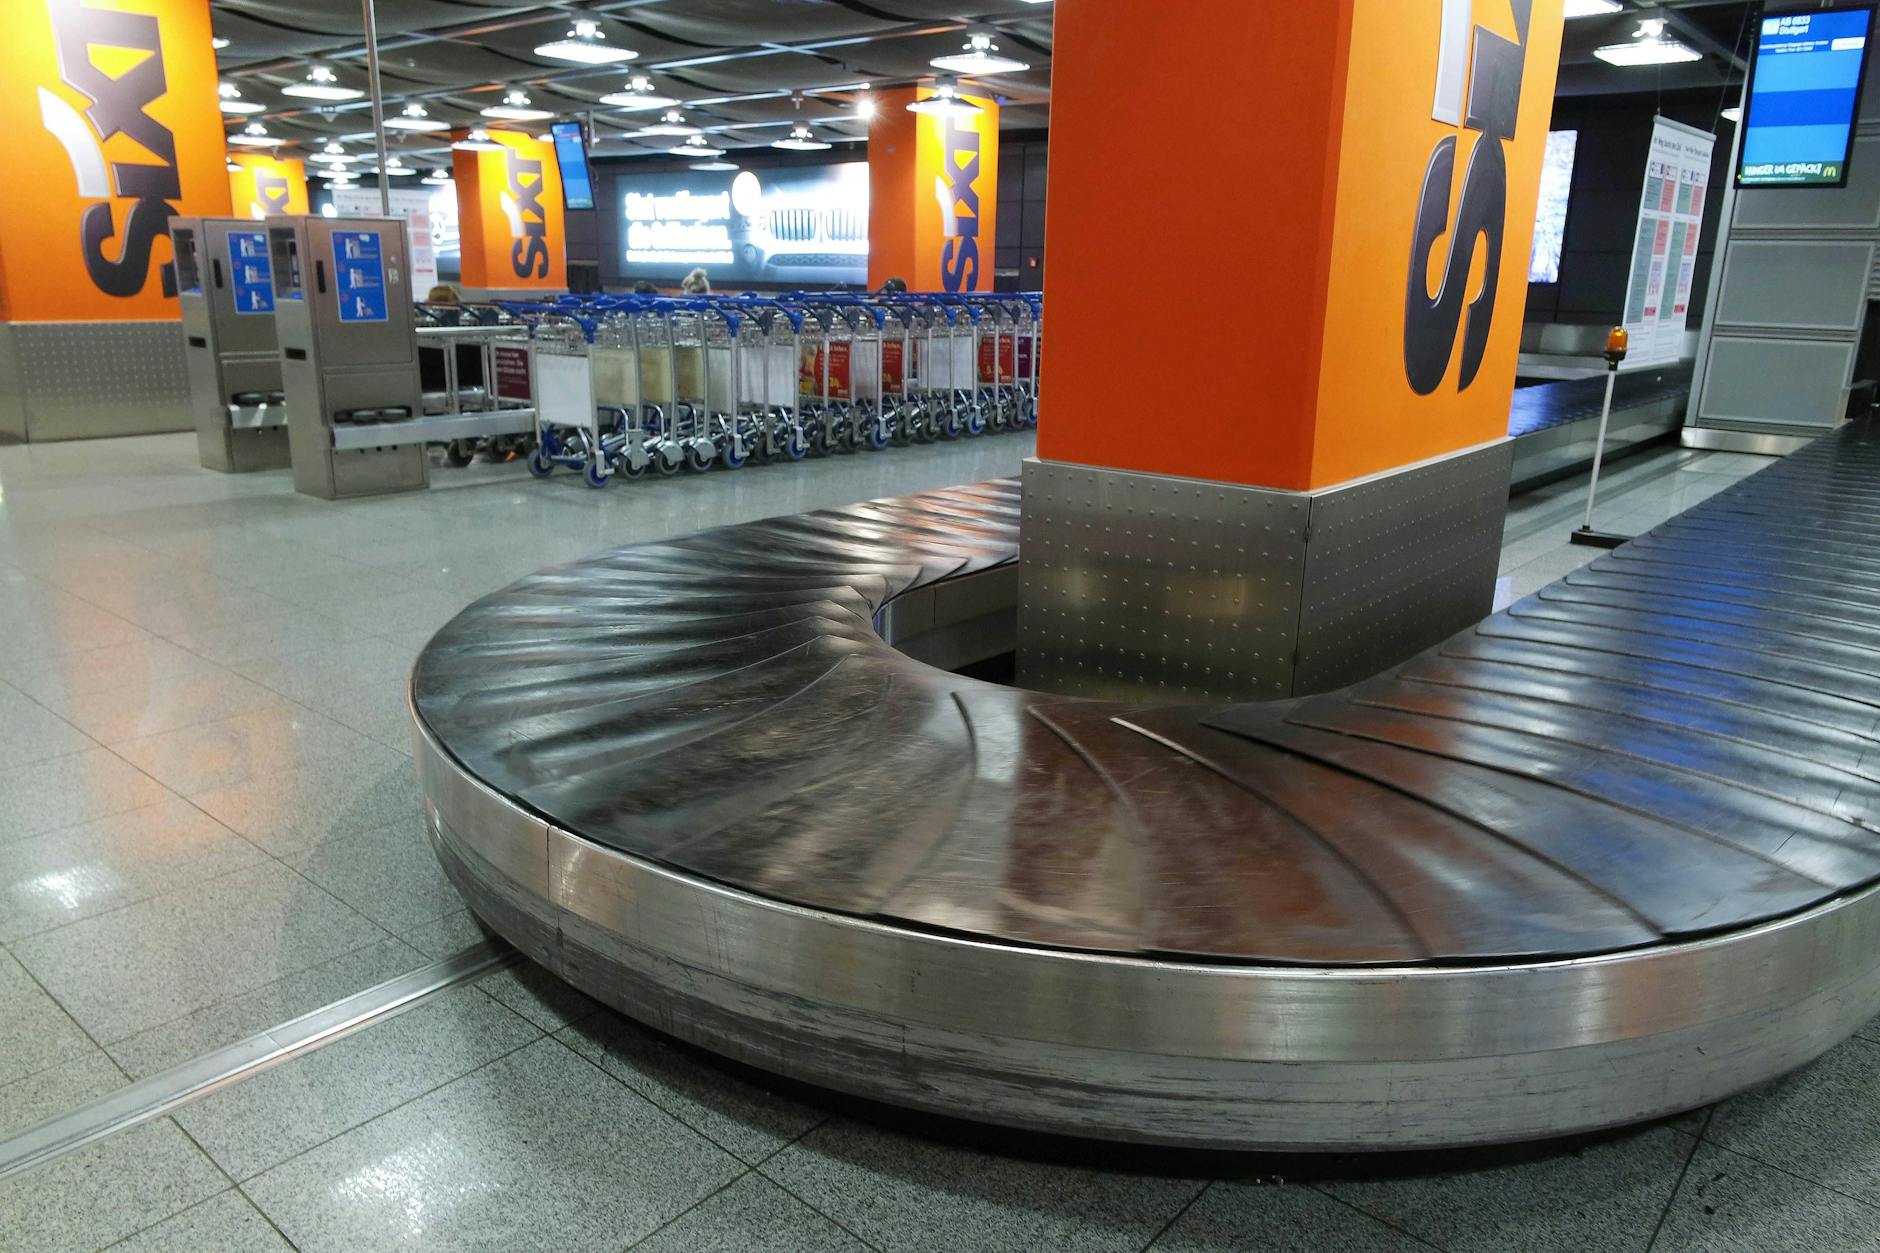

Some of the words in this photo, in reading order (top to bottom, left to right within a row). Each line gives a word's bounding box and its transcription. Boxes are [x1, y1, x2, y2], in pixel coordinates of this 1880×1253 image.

[505, 148, 549, 280] SIXT
[941, 116, 980, 293] SIXT
[1404, 0, 1533, 396] SI
